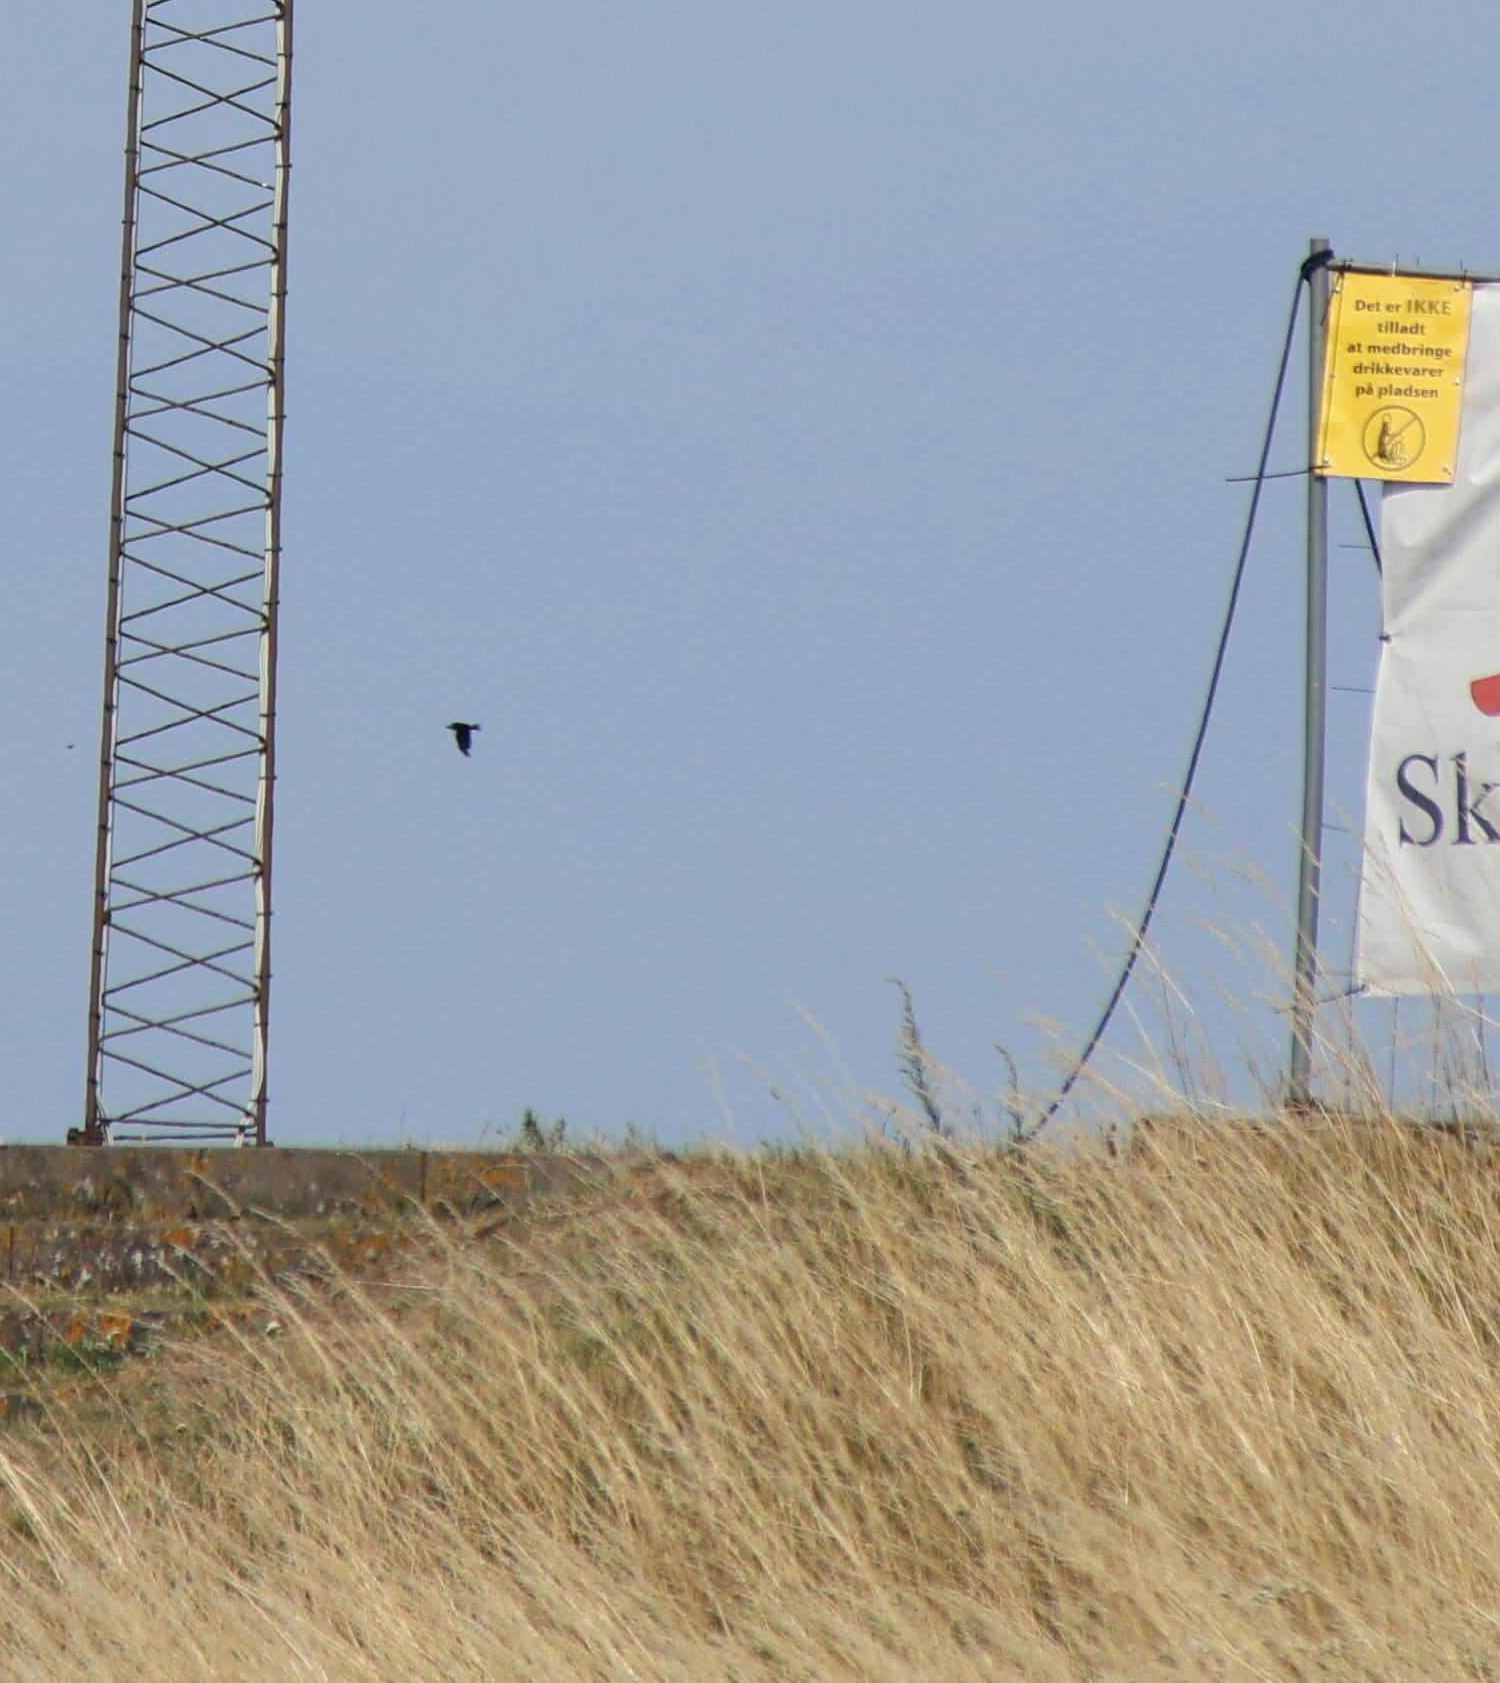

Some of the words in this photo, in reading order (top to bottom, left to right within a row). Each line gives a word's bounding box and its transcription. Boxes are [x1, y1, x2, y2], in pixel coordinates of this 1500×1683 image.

[1355, 299, 1381, 312] Det
[1386, 302, 1402, 312] er
[1406, 299, 1451, 315] IKKE
[1377, 321, 1426, 335] tilladt
[1347, 343, 1362, 353] at
[1367, 343, 1453, 360] medbringe
[1352, 362, 1445, 377] drikkevarer
[1355, 382, 1374, 398] på
[1378, 383, 1439, 399] pladsen
